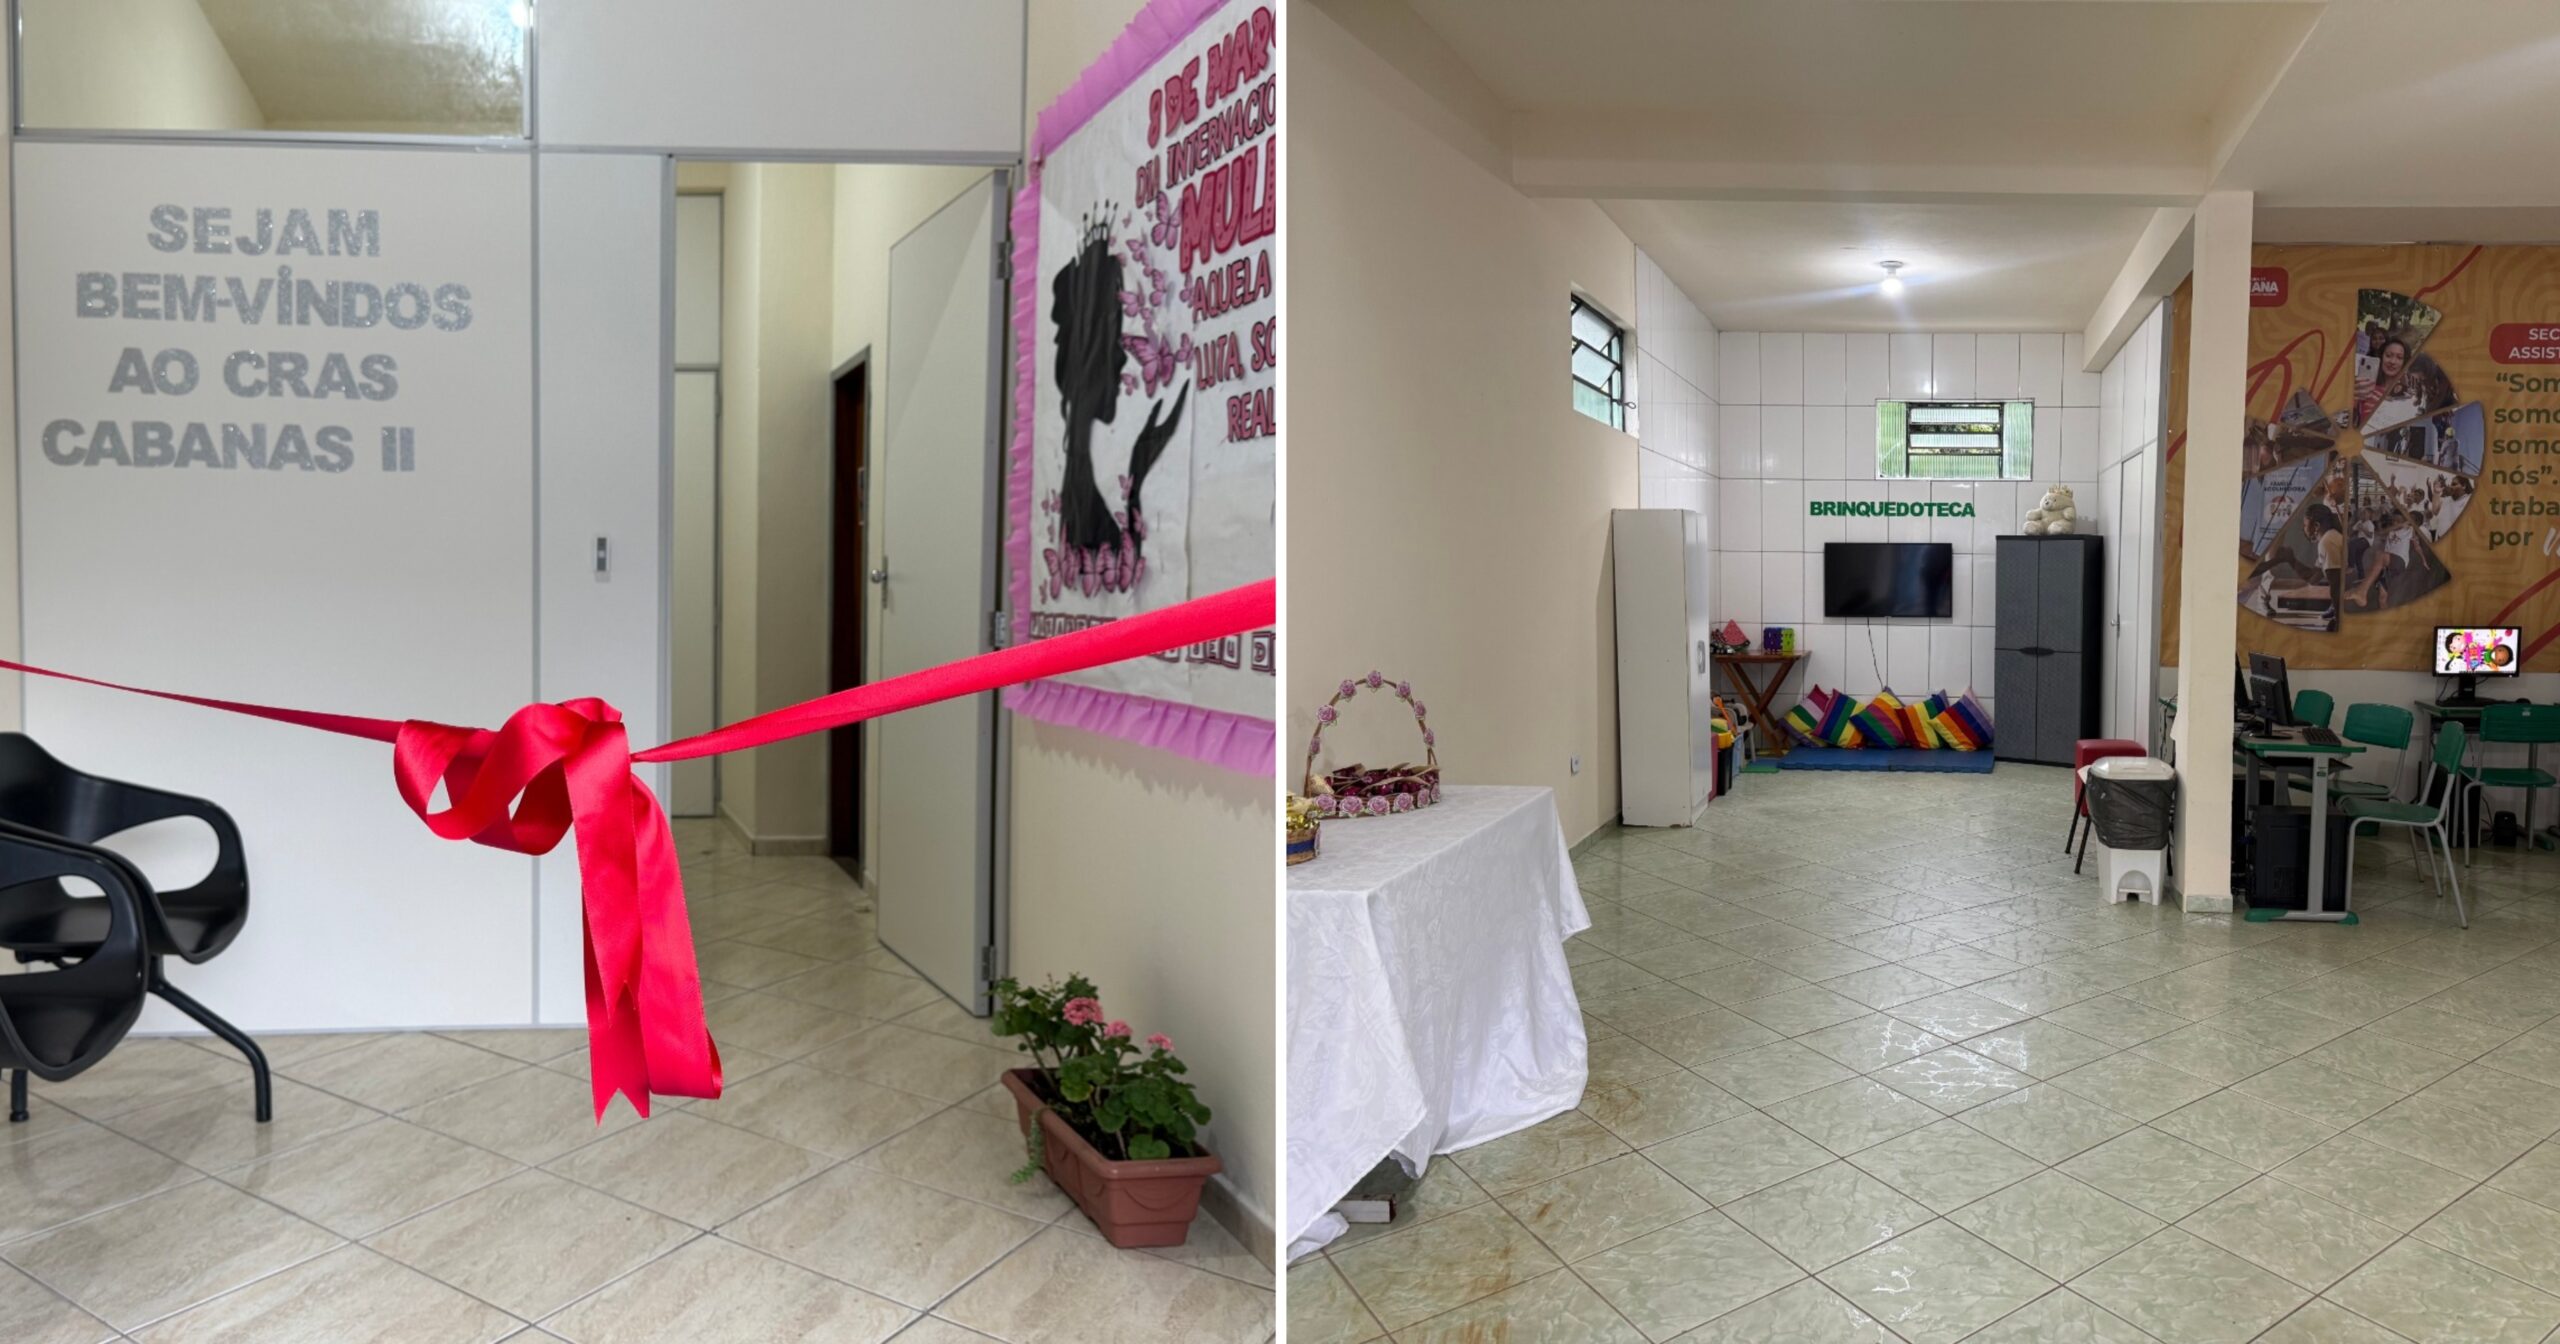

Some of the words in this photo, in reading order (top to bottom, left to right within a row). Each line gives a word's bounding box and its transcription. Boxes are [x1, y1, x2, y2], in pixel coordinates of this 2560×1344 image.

[1164, 55, 1200, 138] DE
[1205, 6, 1276, 110] MAR
[147, 204, 381, 257] SEJAM
[1192, 249, 1272, 324] AQUELA
[2251, 281, 2279, 293] ANA
[107, 347, 200, 396] AO
[222, 350, 400, 402] CRAS
[41, 418, 355, 474] CABANAS
[381, 426, 416, 473] II
[1809, 501, 1976, 518] BRINQUEDOTECA
[2489, 496, 2560, 516] traba
[2489, 530, 2534, 551] por
